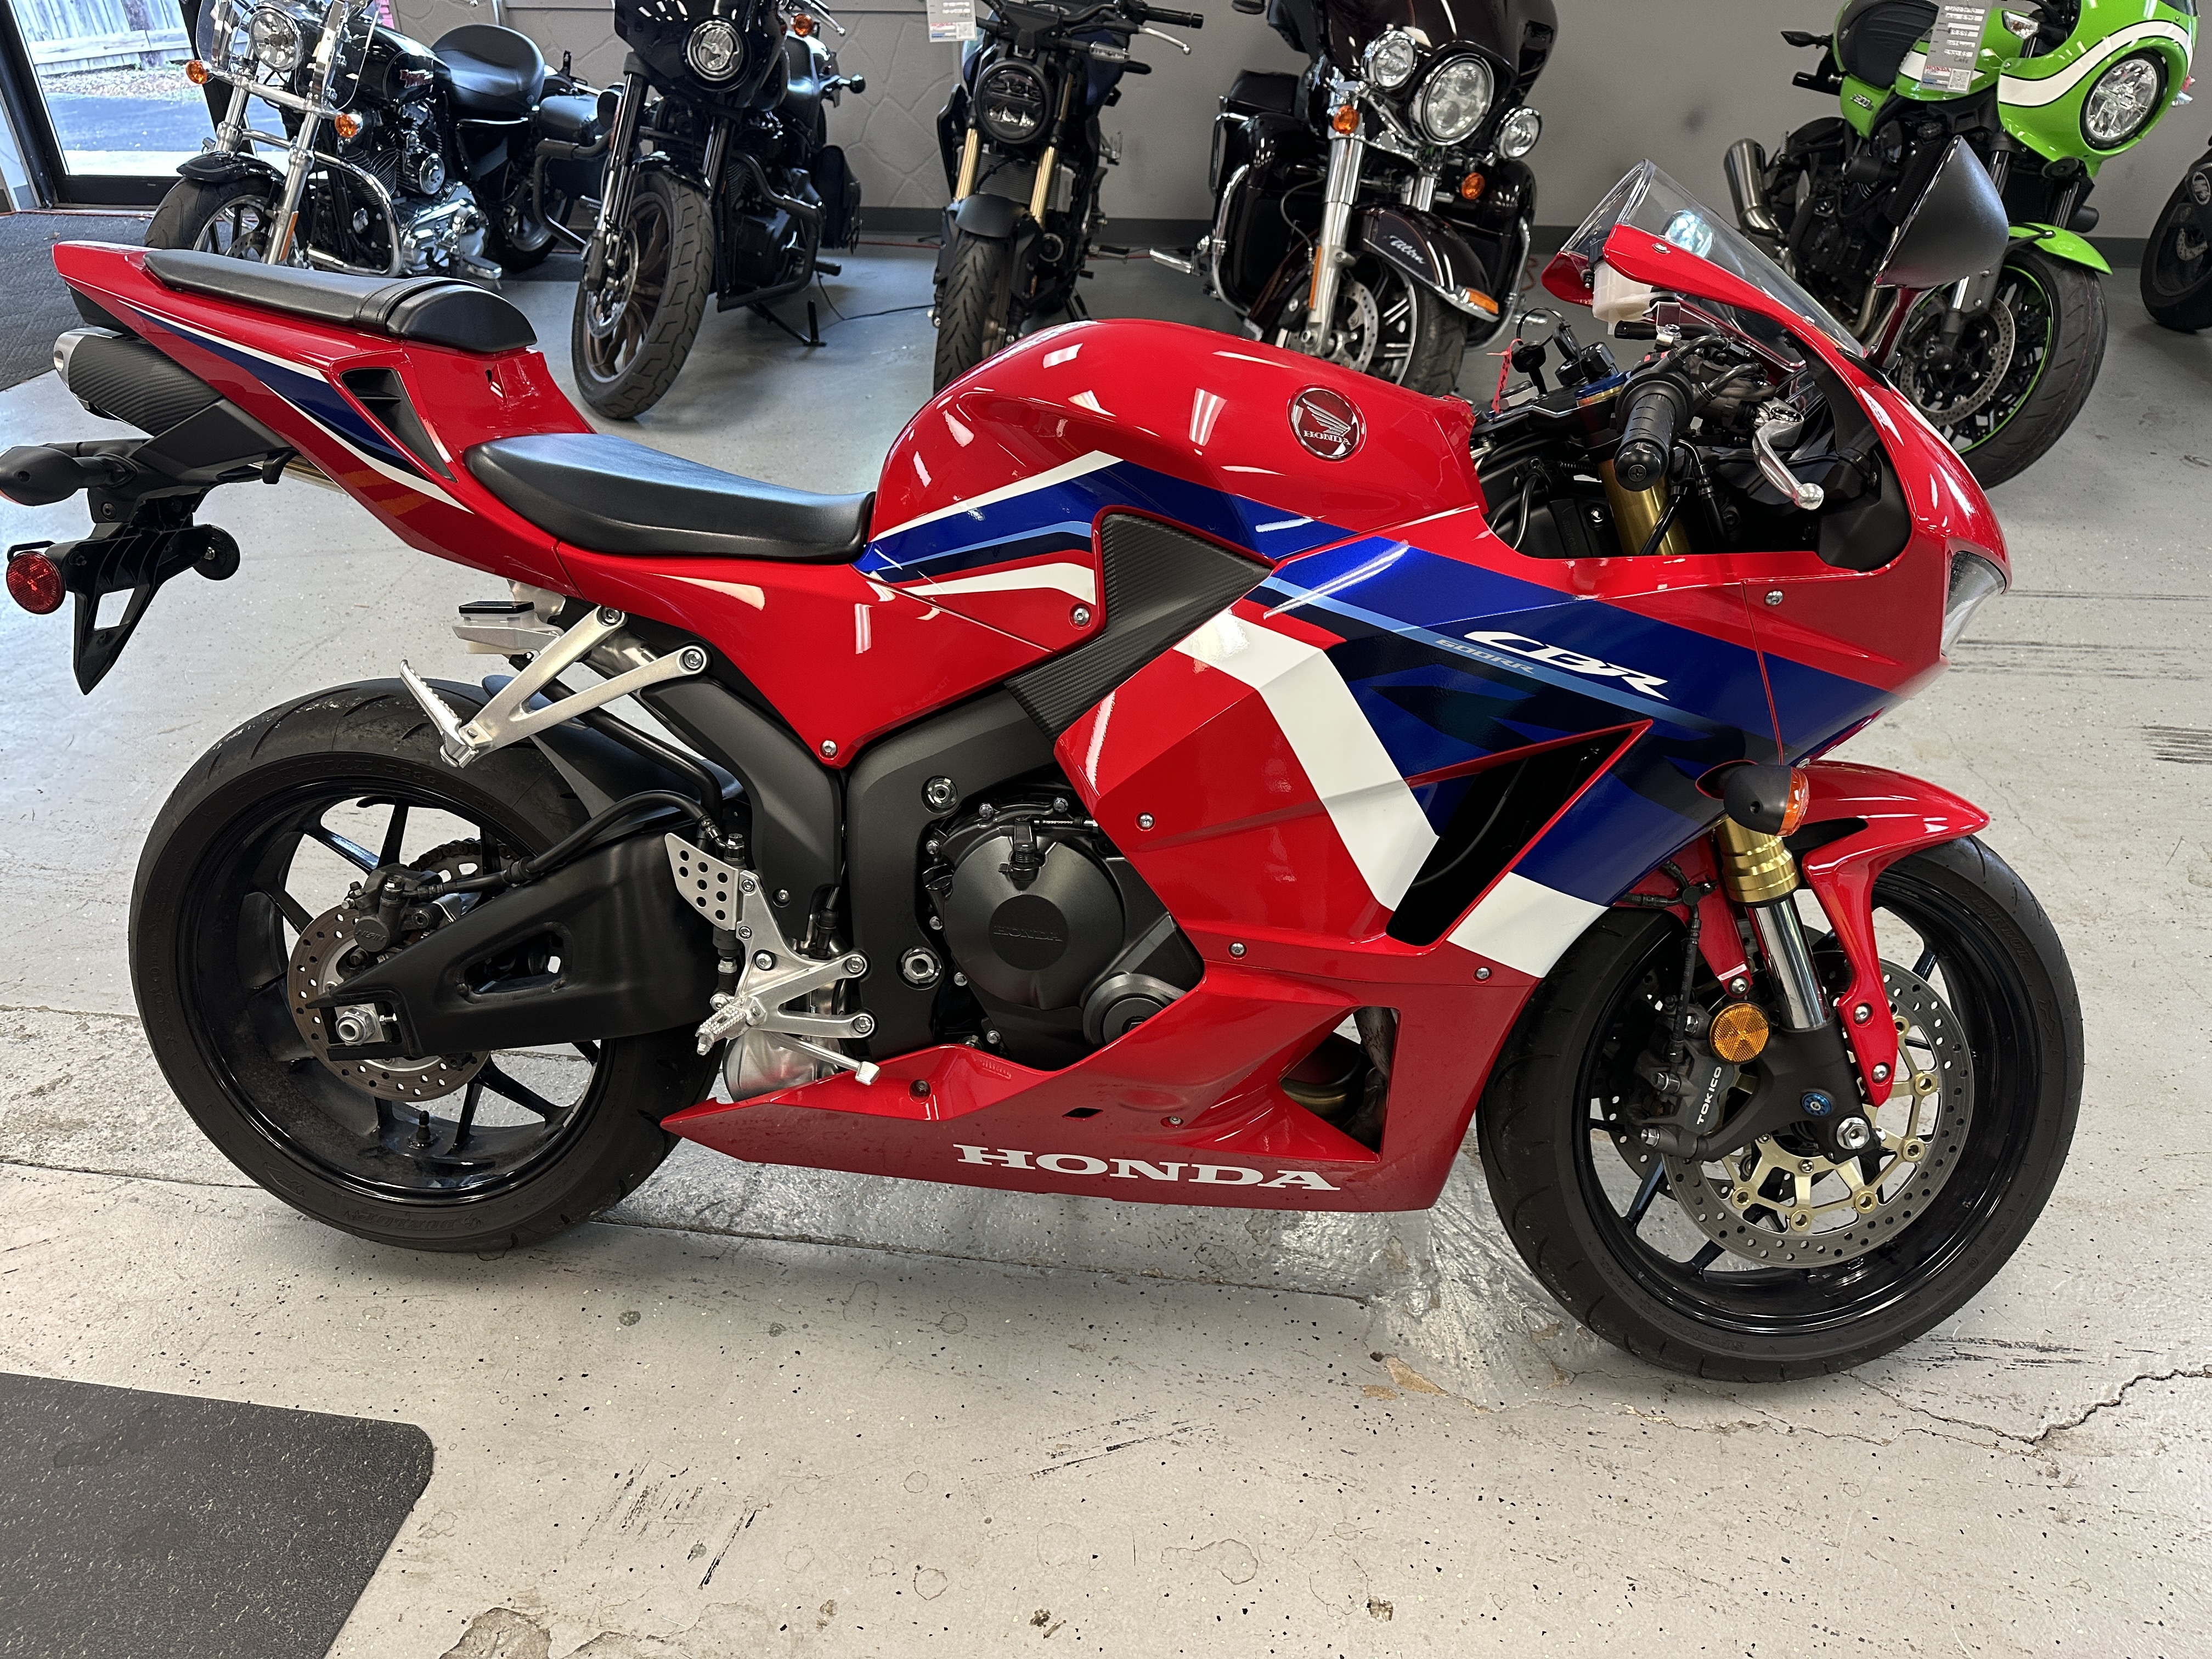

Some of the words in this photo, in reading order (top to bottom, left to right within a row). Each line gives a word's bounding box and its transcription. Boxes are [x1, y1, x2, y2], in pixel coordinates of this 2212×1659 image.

[1303, 430, 1352, 446] HONDA
[1435, 639, 1534, 674] 600RR
[1464, 631, 1669, 700] CBR
[992, 926, 1063, 943] HONDA
[1696, 1066, 1722, 1125] TOKICO
[953, 1143, 1341, 1191] HONDA
